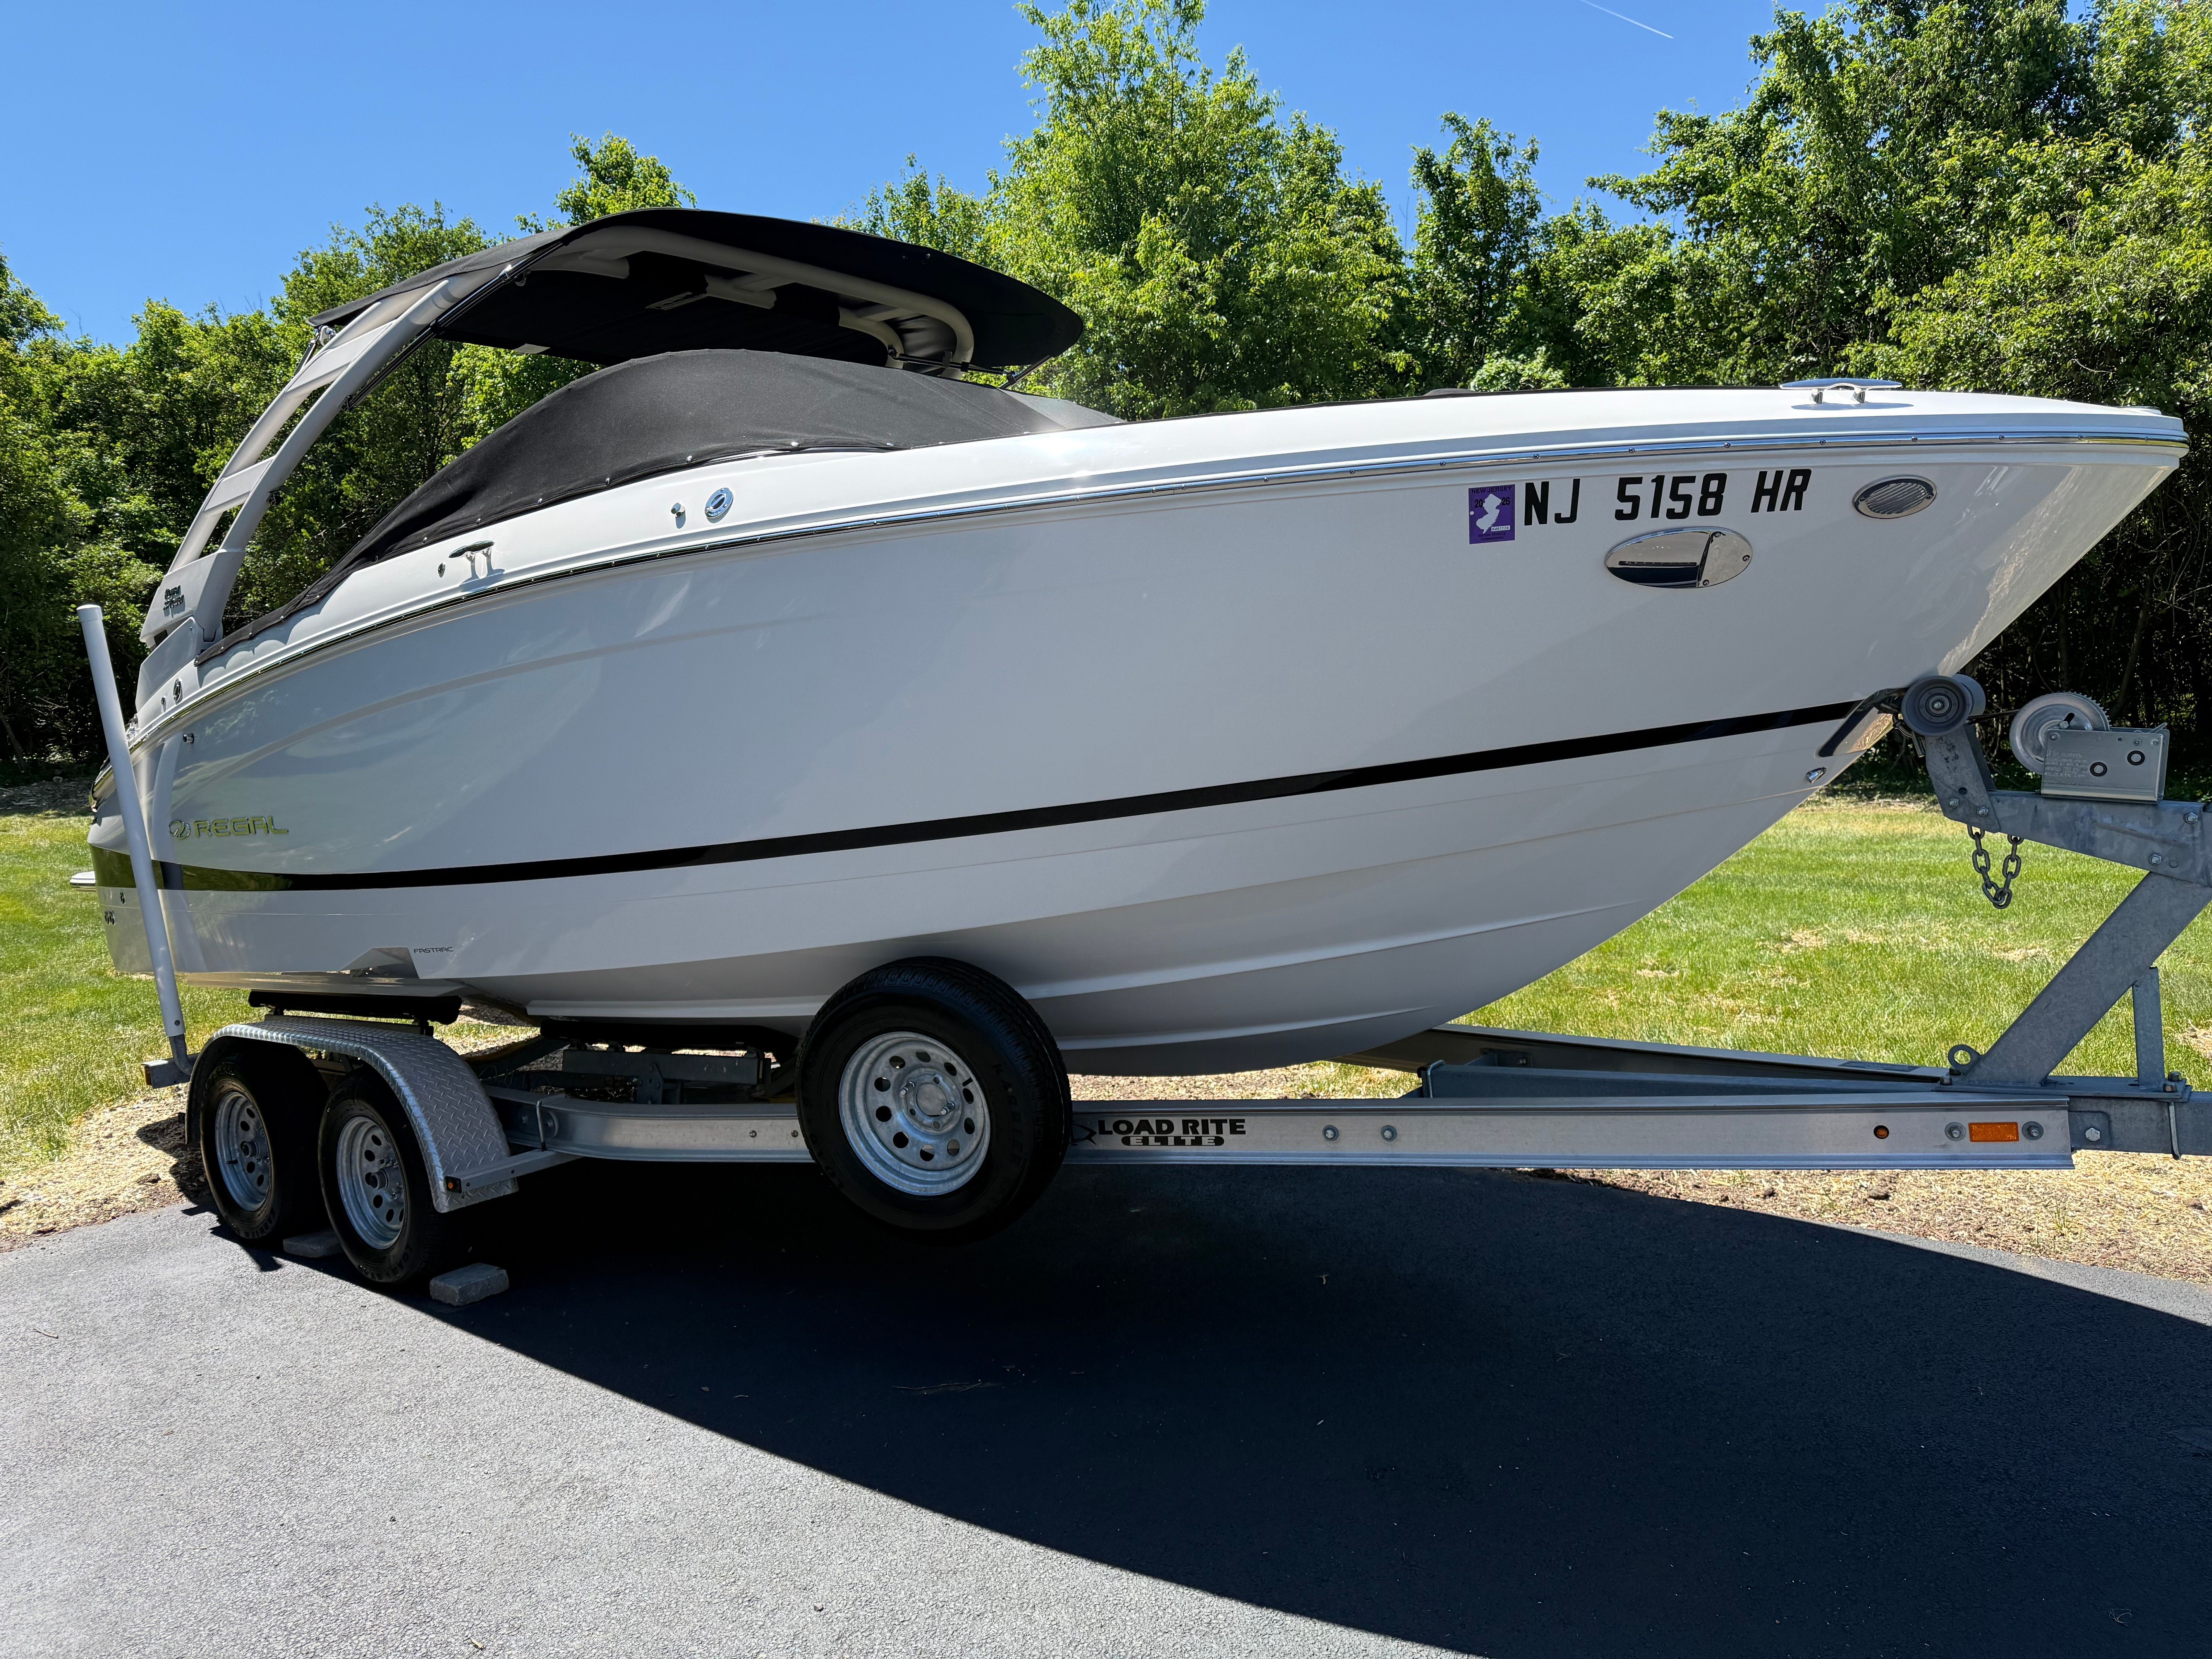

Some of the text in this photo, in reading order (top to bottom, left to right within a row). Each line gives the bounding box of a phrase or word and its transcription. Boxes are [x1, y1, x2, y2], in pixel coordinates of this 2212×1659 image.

[1475, 496, 1510, 508] 20 26
[1524, 469, 1812, 526] NJ 5158 HR
[193, 815, 289, 838] REGAL
[1098, 1118, 1246, 1135] LOAD RITE
[1130, 1136, 1216, 1146] ELITE
